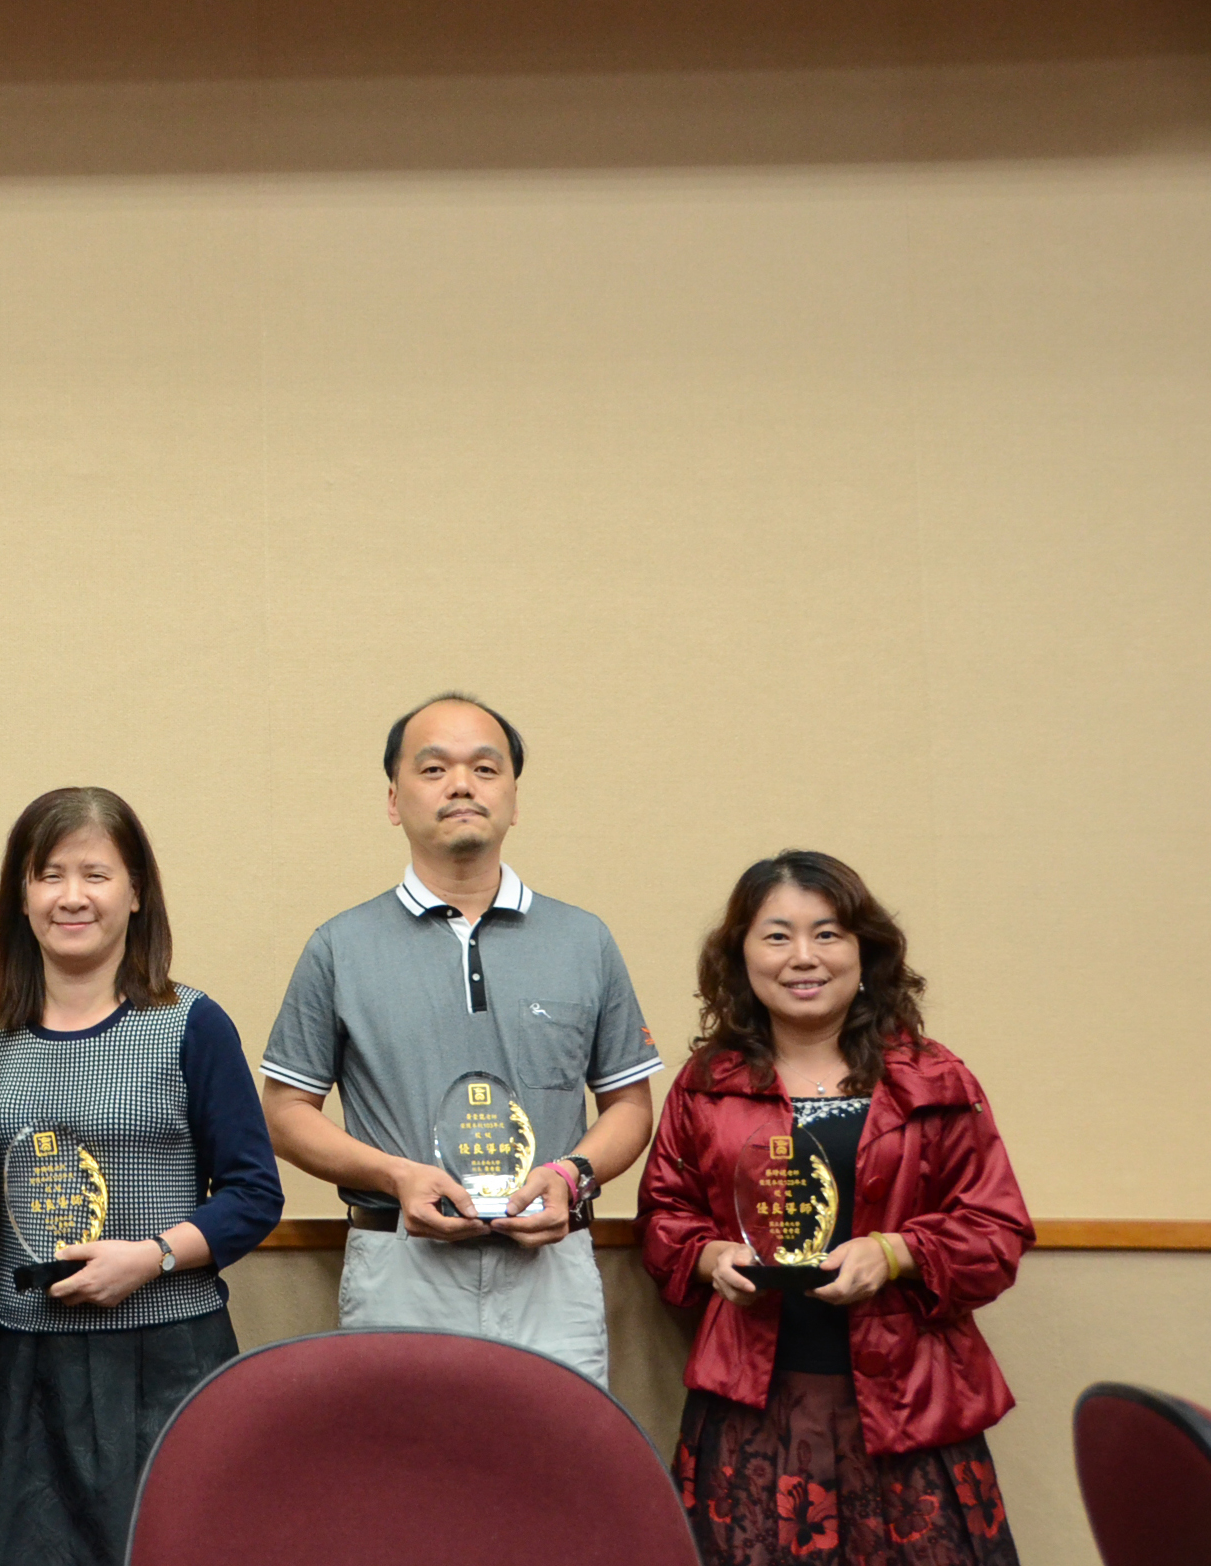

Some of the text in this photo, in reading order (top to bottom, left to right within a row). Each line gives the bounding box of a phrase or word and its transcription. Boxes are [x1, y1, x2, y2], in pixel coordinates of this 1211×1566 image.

[458, 1142, 512, 1155] 優良導師
[756, 1201, 813, 1215] 優良導師
